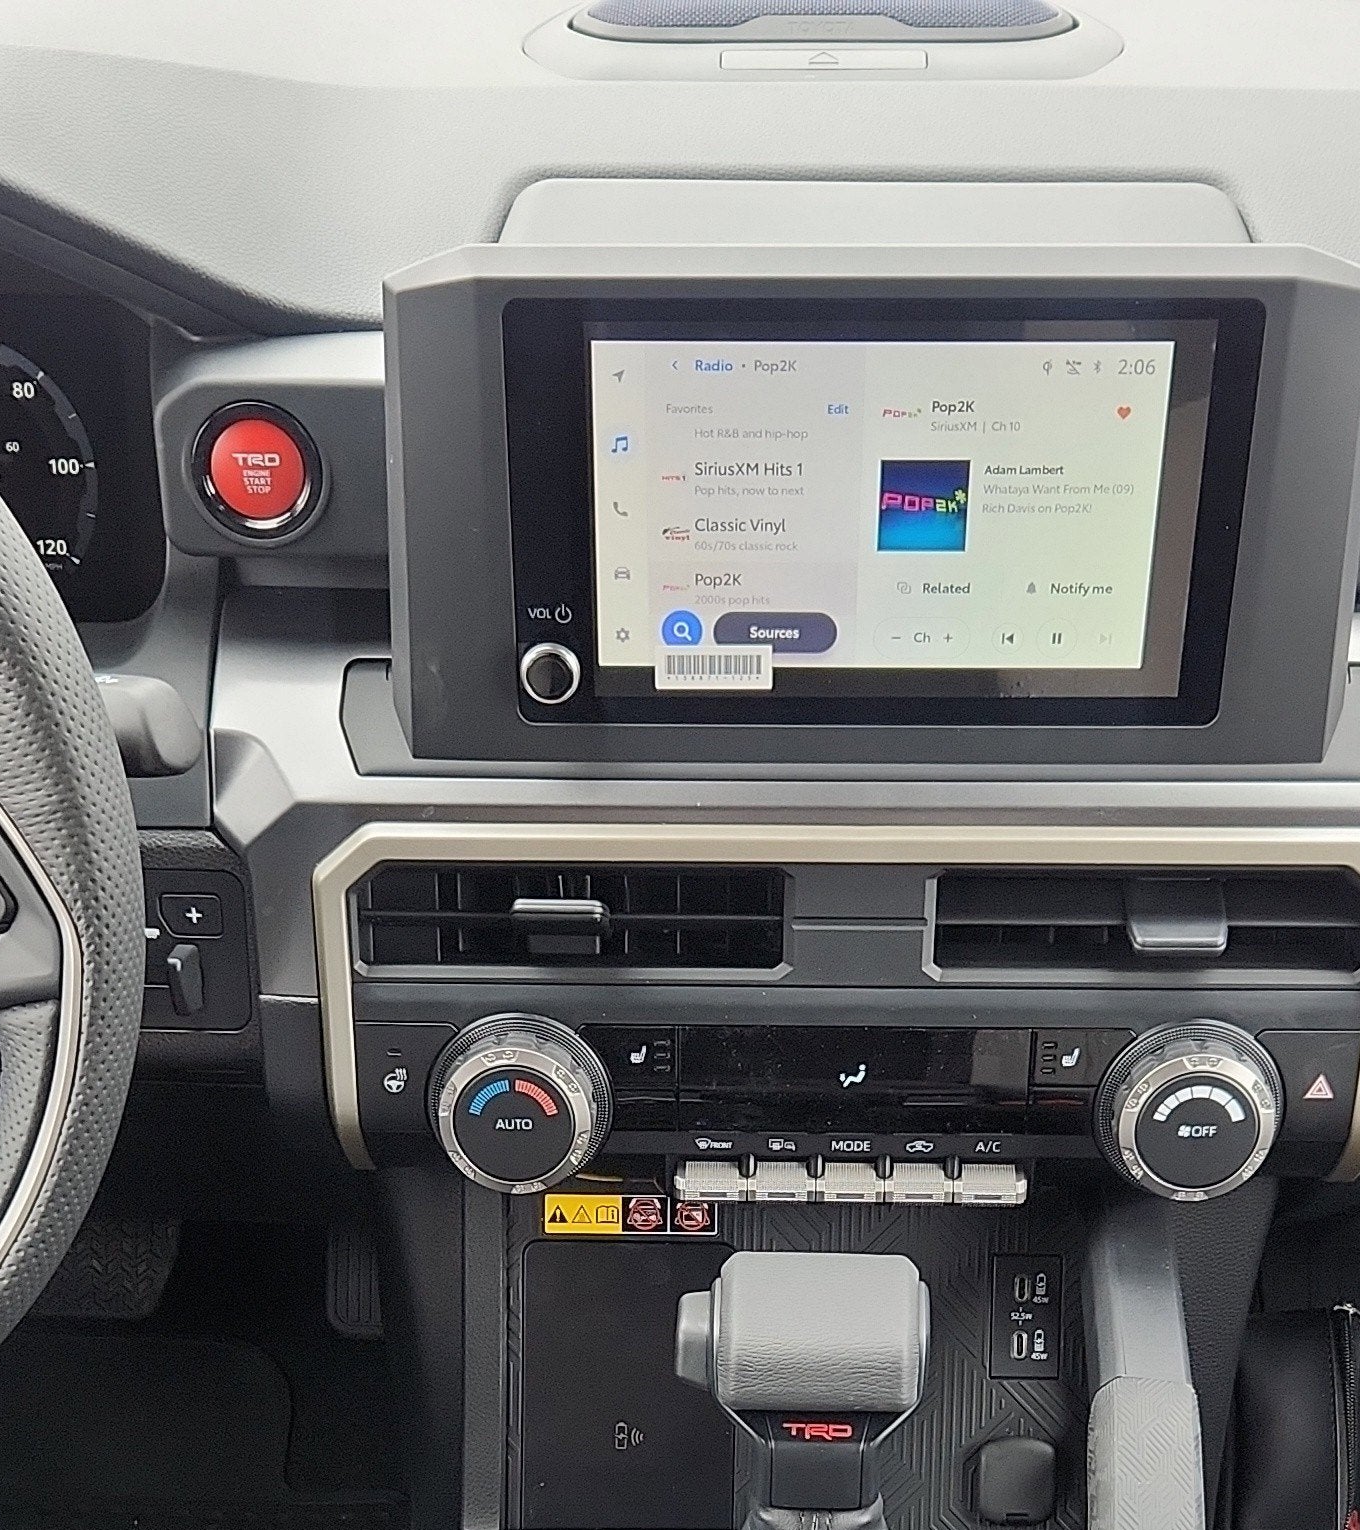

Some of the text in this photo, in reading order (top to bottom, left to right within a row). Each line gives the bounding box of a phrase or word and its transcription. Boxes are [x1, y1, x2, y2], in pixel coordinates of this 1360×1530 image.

[694, 360, 797, 376] Radio Pop2K
[1117, 359, 1156, 376] 2:06
[12, 382, 35, 399] 80
[665, 403, 714, 415] Favorites
[826, 403, 849, 415] Edit
[931, 400, 975, 416] Pop2K
[930, 420, 1021, 433] SiriusXM Ch 10
[694, 427, 809, 442] Hot R&B and hip-hop
[5, 441, 20, 453] 60
[48, 458, 80, 475] 100
[231, 453, 281, 468] TRD
[242, 469, 271, 477] ENGINE
[694, 461, 804, 478] SiriusXM Hits 1
[984, 464, 1064, 476] Adam Lambert
[243, 477, 272, 485] START
[246, 485, 272, 494] STOP
[694, 485, 716, 498] Pop
[742, 487, 763, 496] now
[766, 486, 778, 496] to
[780, 486, 805, 496] next
[983, 483, 1135, 497] Whataya Want From Me (09)
[982, 503, 1005, 514] Rich
[1007, 503, 1036, 514] Davis
[1038, 506, 1052, 514] on
[694, 518, 747, 533] Classic
[749, 518, 786, 537] Vinyl
[36, 539, 68, 555] 120
[694, 540, 799, 553] 60s/70s classic rock
[694, 573, 742, 589] Pop2K
[922, 582, 971, 595] Related
[1049, 582, 1113, 598] Notify me
[694, 594, 770, 607] 2000s pop hits
[527, 607, 552, 620] VOL
[748, 626, 800, 640] Sources
[913, 632, 931, 644] Ch
[494, 1118, 533, 1131] AUTO
[1190, 1125, 1217, 1138] OFF
[709, 1140, 733, 1149] FRONT
[830, 1139, 871, 1152] MODE
[975, 1139, 1002, 1153] A/C
[1032, 1296, 1050, 1304] 45W
[1030, 1352, 1049, 1360] 45W
[782, 1421, 853, 1441] TRD
